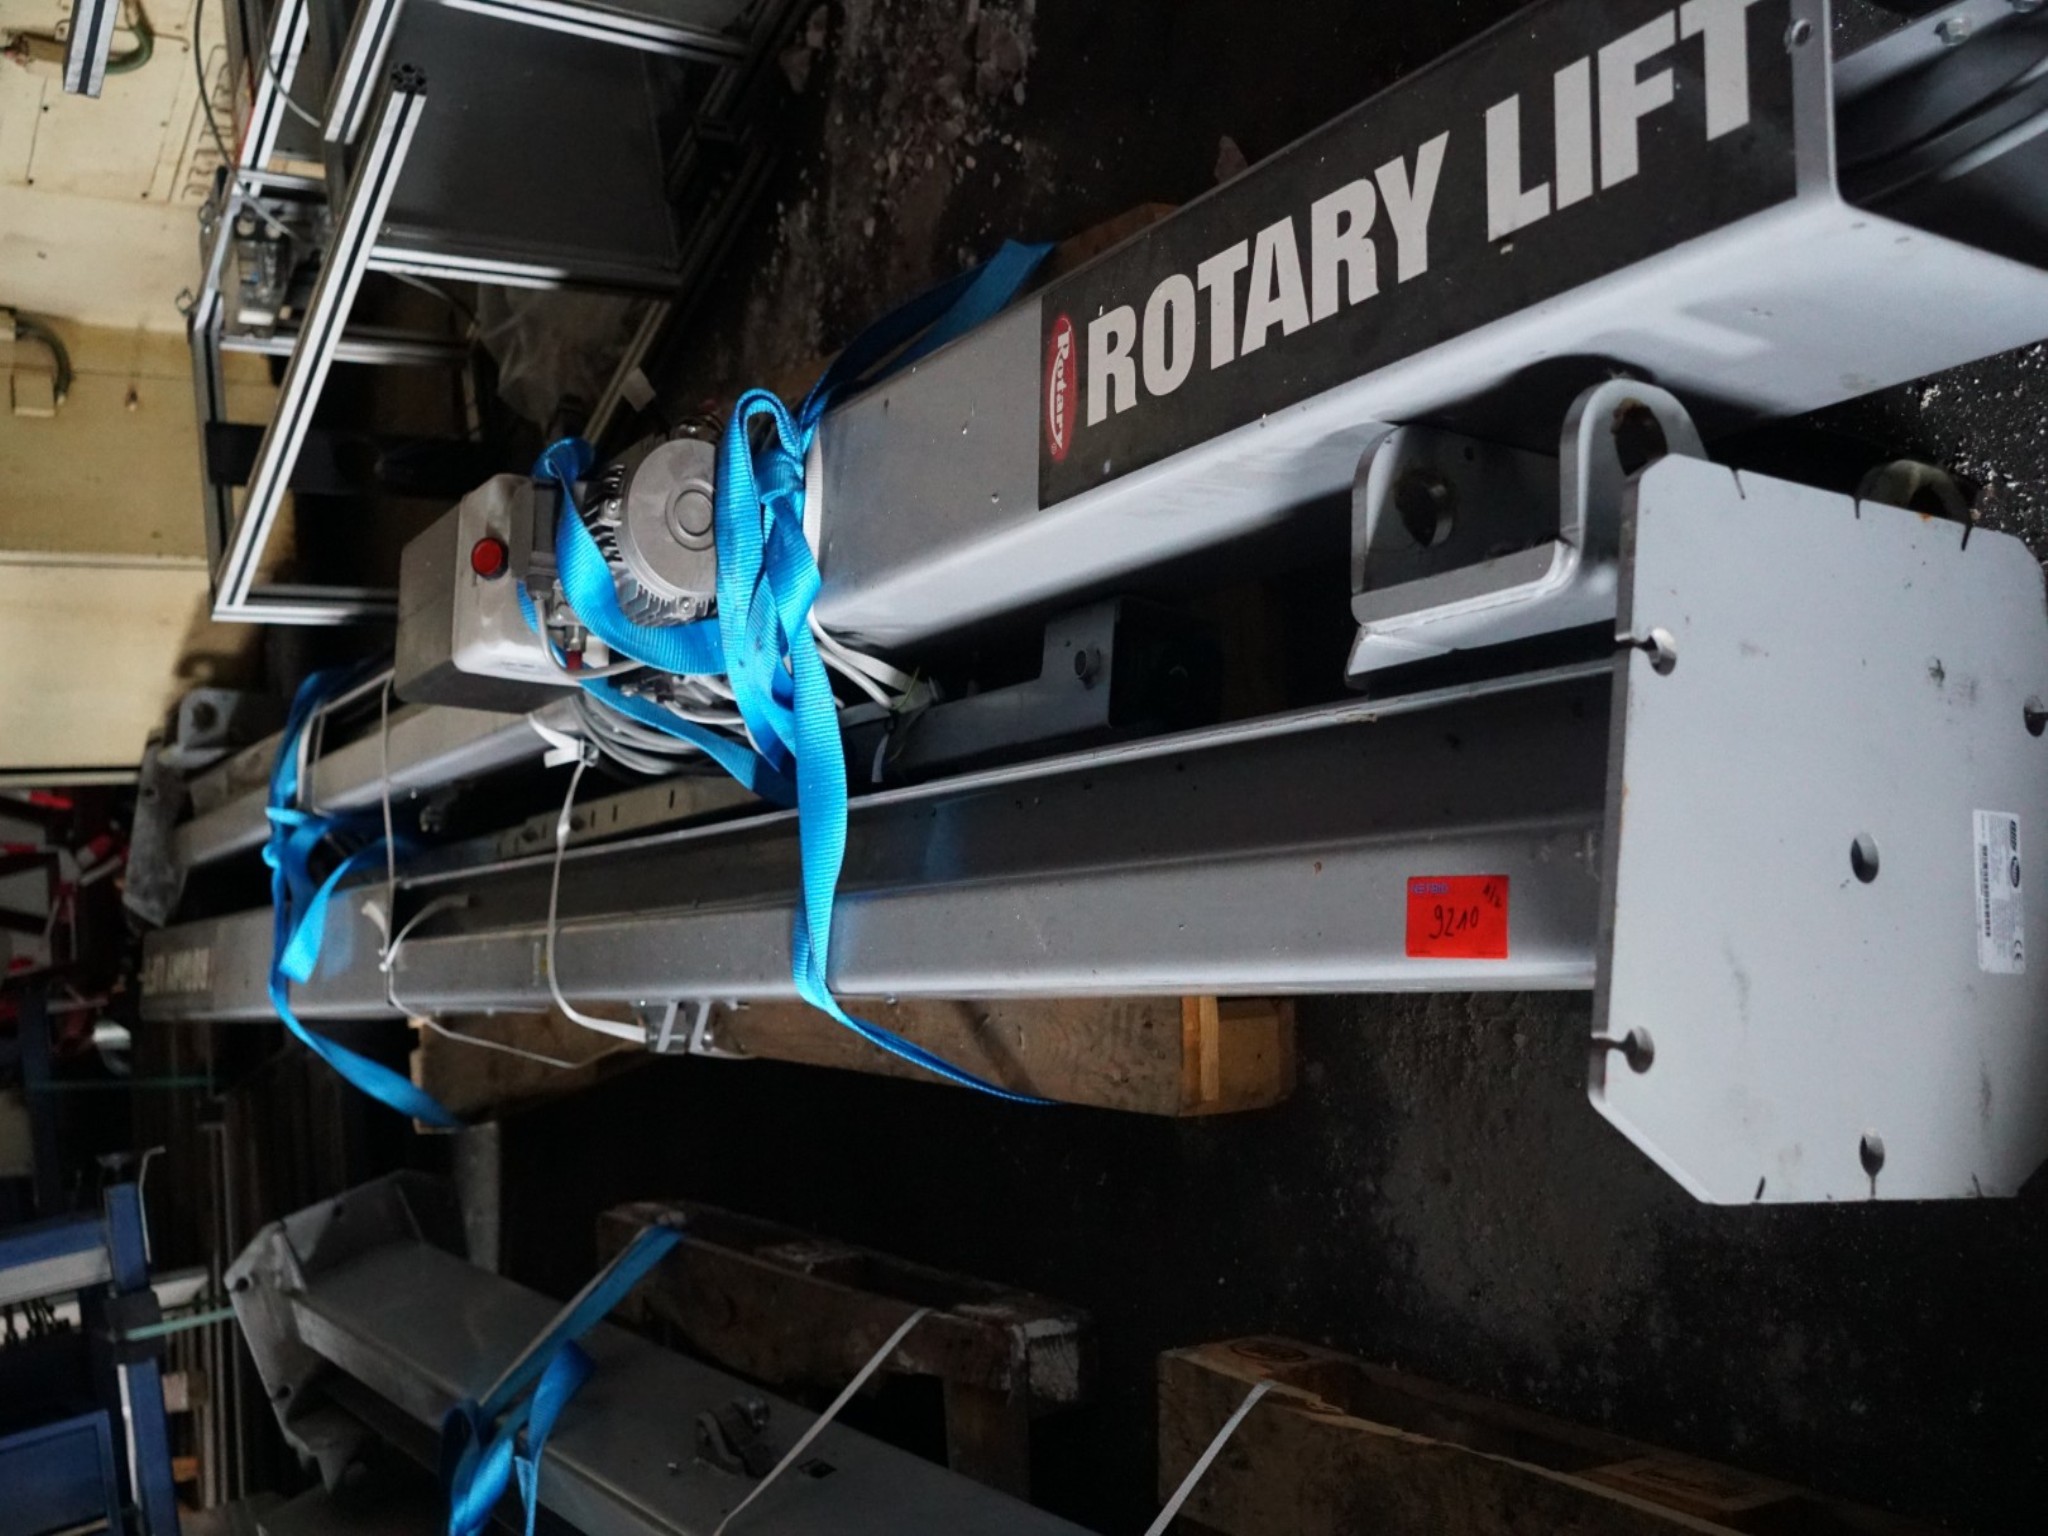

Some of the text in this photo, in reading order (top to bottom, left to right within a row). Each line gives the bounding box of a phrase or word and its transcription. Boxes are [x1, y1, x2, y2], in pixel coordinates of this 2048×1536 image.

[1087, 0, 1765, 428] ROTARY LIFT
[1050, 325, 1073, 450] Rotary
[1428, 904, 1479, 939] 9210
